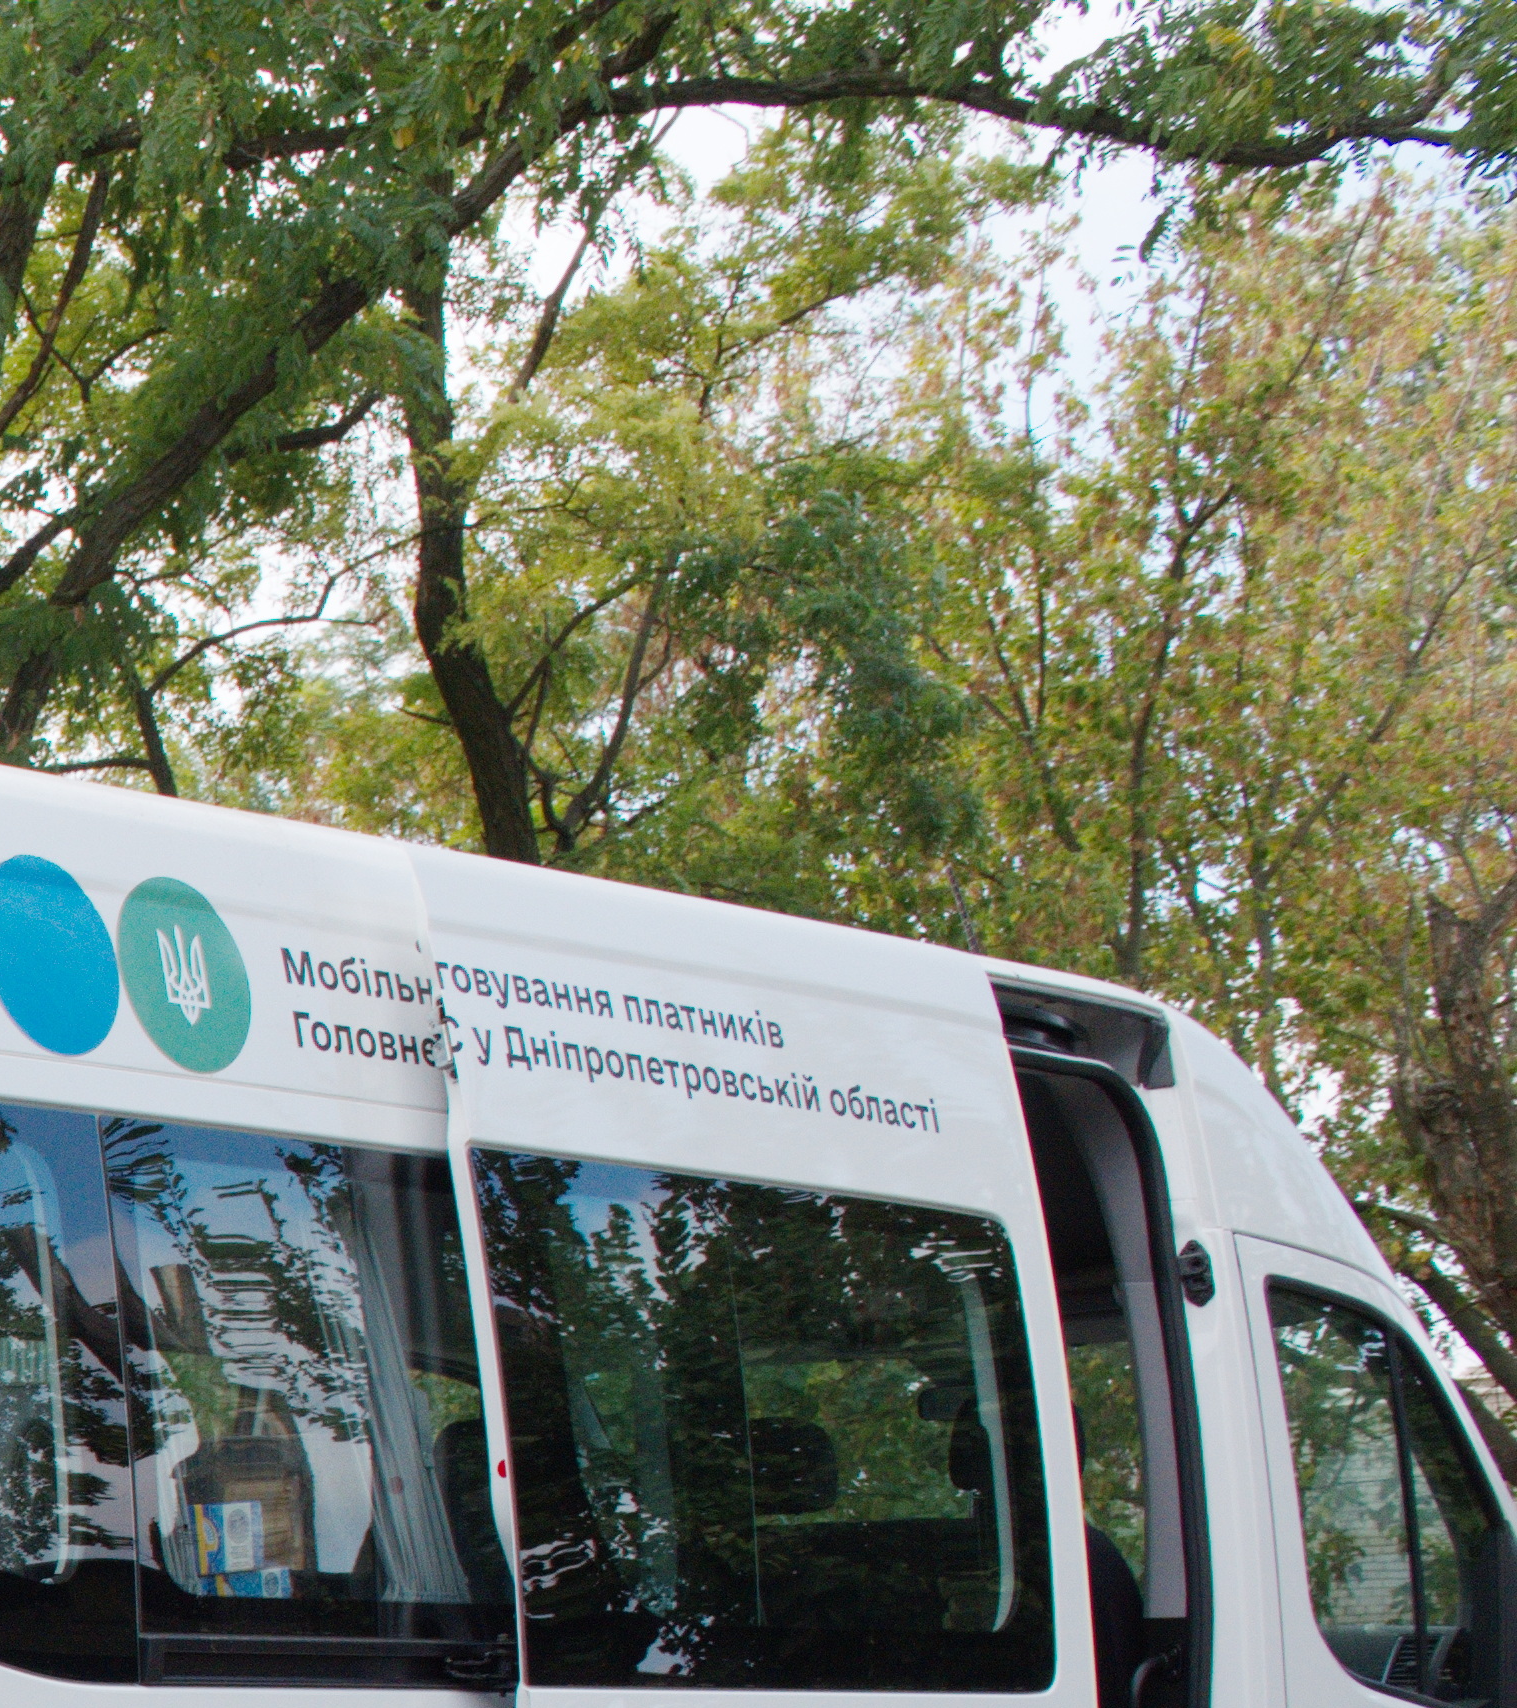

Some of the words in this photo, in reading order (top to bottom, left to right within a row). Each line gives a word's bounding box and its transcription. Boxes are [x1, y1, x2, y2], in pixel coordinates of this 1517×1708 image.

[280, 947, 433, 1005] Мобільн
[434, 961, 614, 1019] говування
[622, 994, 785, 1049] платників
[470, 1027, 492, 1067] у
[503, 1024, 822, 1113] Дніпропетровській
[829, 1084, 941, 1134] області
